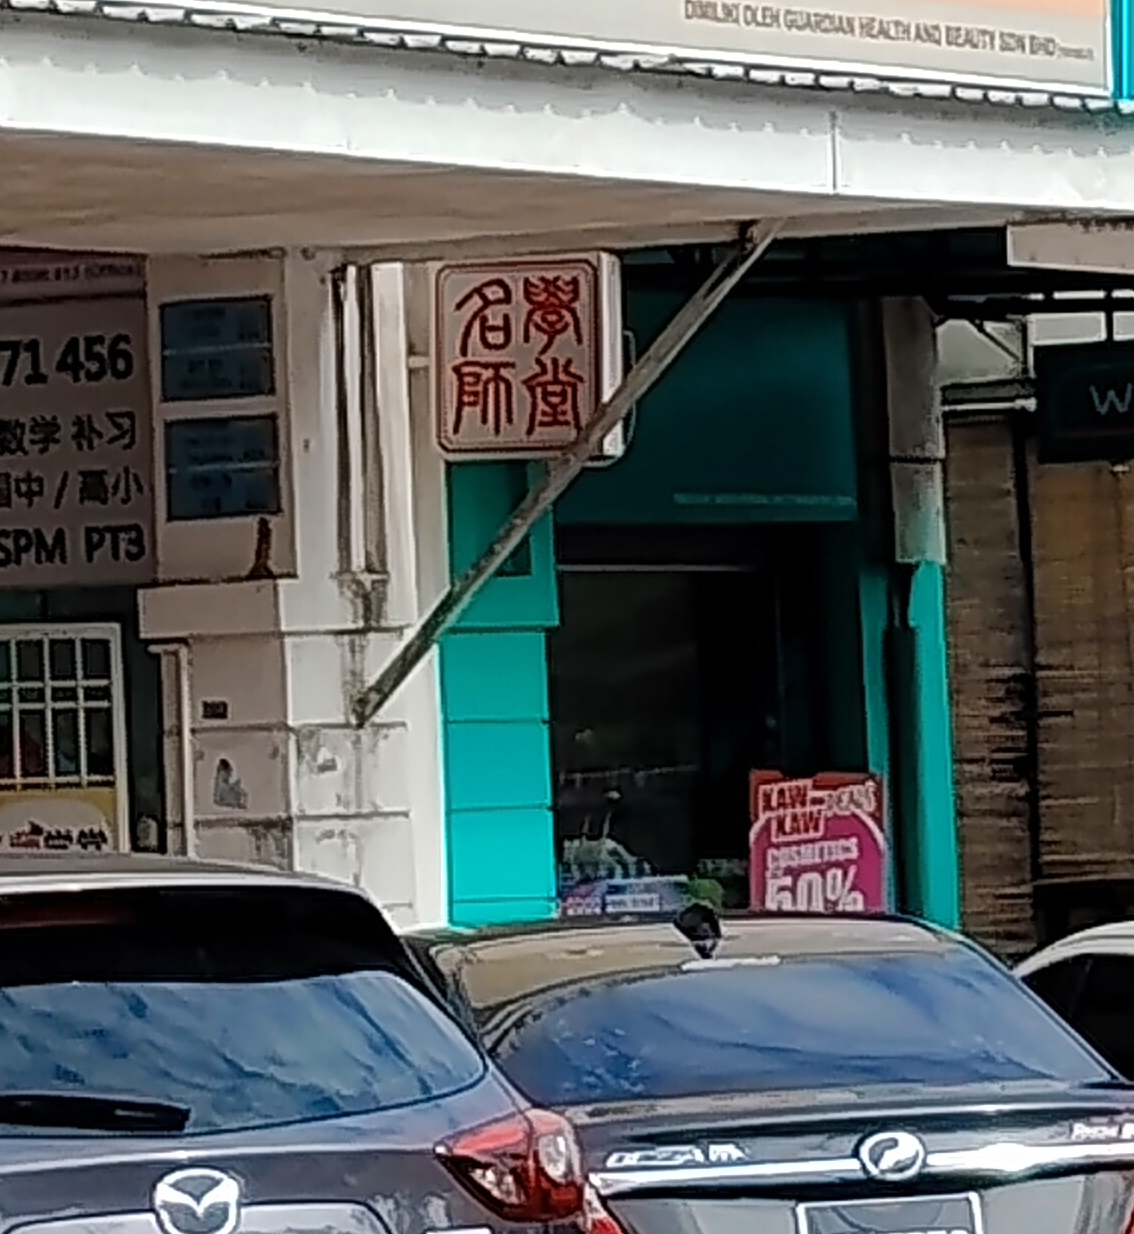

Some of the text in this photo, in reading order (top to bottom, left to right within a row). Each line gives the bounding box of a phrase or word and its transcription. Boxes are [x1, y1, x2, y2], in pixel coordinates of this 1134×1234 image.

[783, 8, 855, 37] GUARDIAN
[857, 16, 911, 42] HEALTH
[913, 22, 942, 47] AND
[944, 25, 996, 51] BEAUTY
[84, 522, 146, 563] PT3
